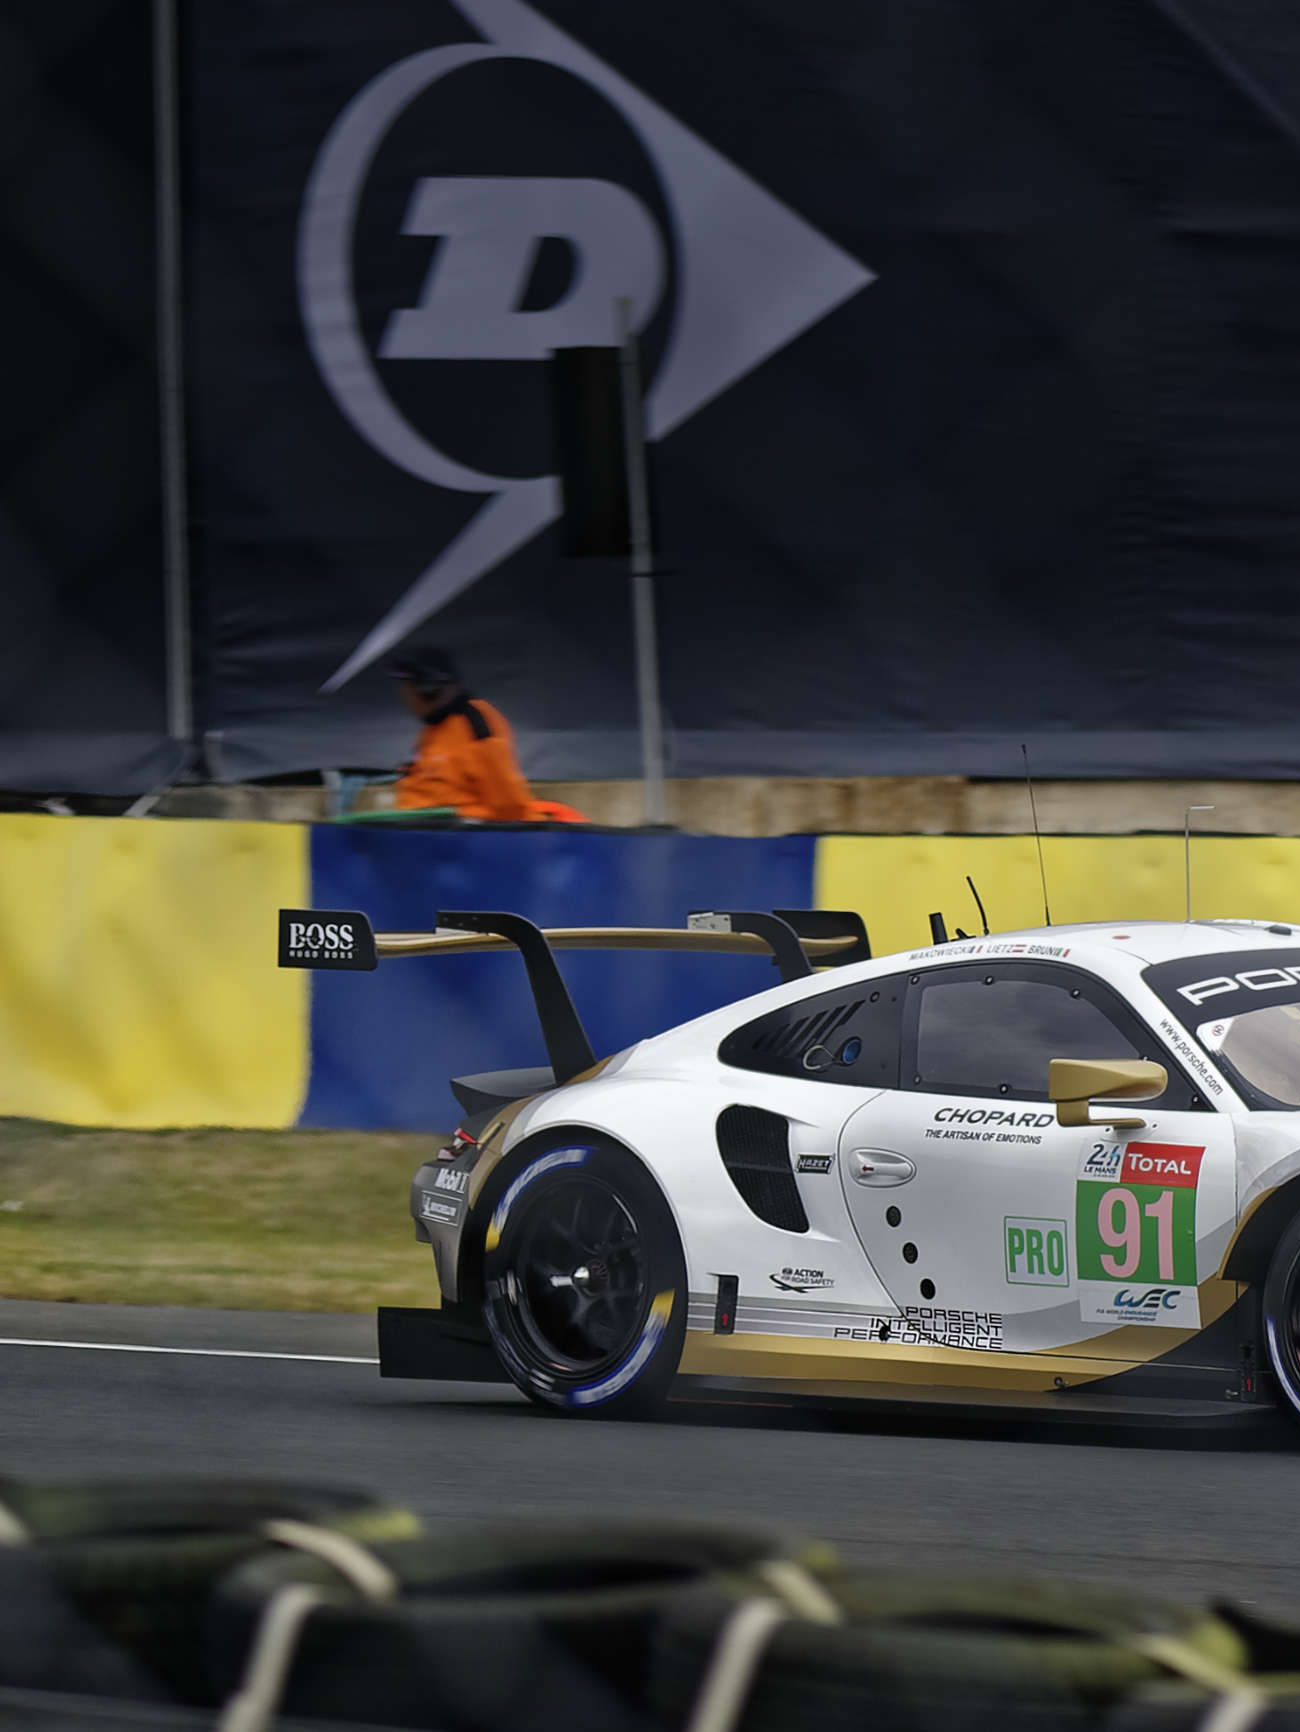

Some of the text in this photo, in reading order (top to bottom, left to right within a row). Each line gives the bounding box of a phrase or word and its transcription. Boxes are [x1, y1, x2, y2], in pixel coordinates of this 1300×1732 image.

[378, 176, 668, 361] D
[289, 923, 354, 950] BOSS
[289, 950, 354, 959] HUGO BOSS
[1160, 1018, 1224, 1096] www.porsche.com
[933, 1107, 1055, 1128] CHOPARD
[925, 1129, 1042, 1145] THE ARTISAN OF EMOTIONS
[1128, 1153, 1192, 1175] TOTAL
[1098, 1187, 1175, 1280] 91
[1007, 1227, 1065, 1276] PRO
[793, 1268, 825, 1279] ACTION
[1113, 1288, 1182, 1310] WEC
[906, 1306, 1003, 1324] PORSCHE
[871, 1317, 1003, 1337] INTELLIGENT
